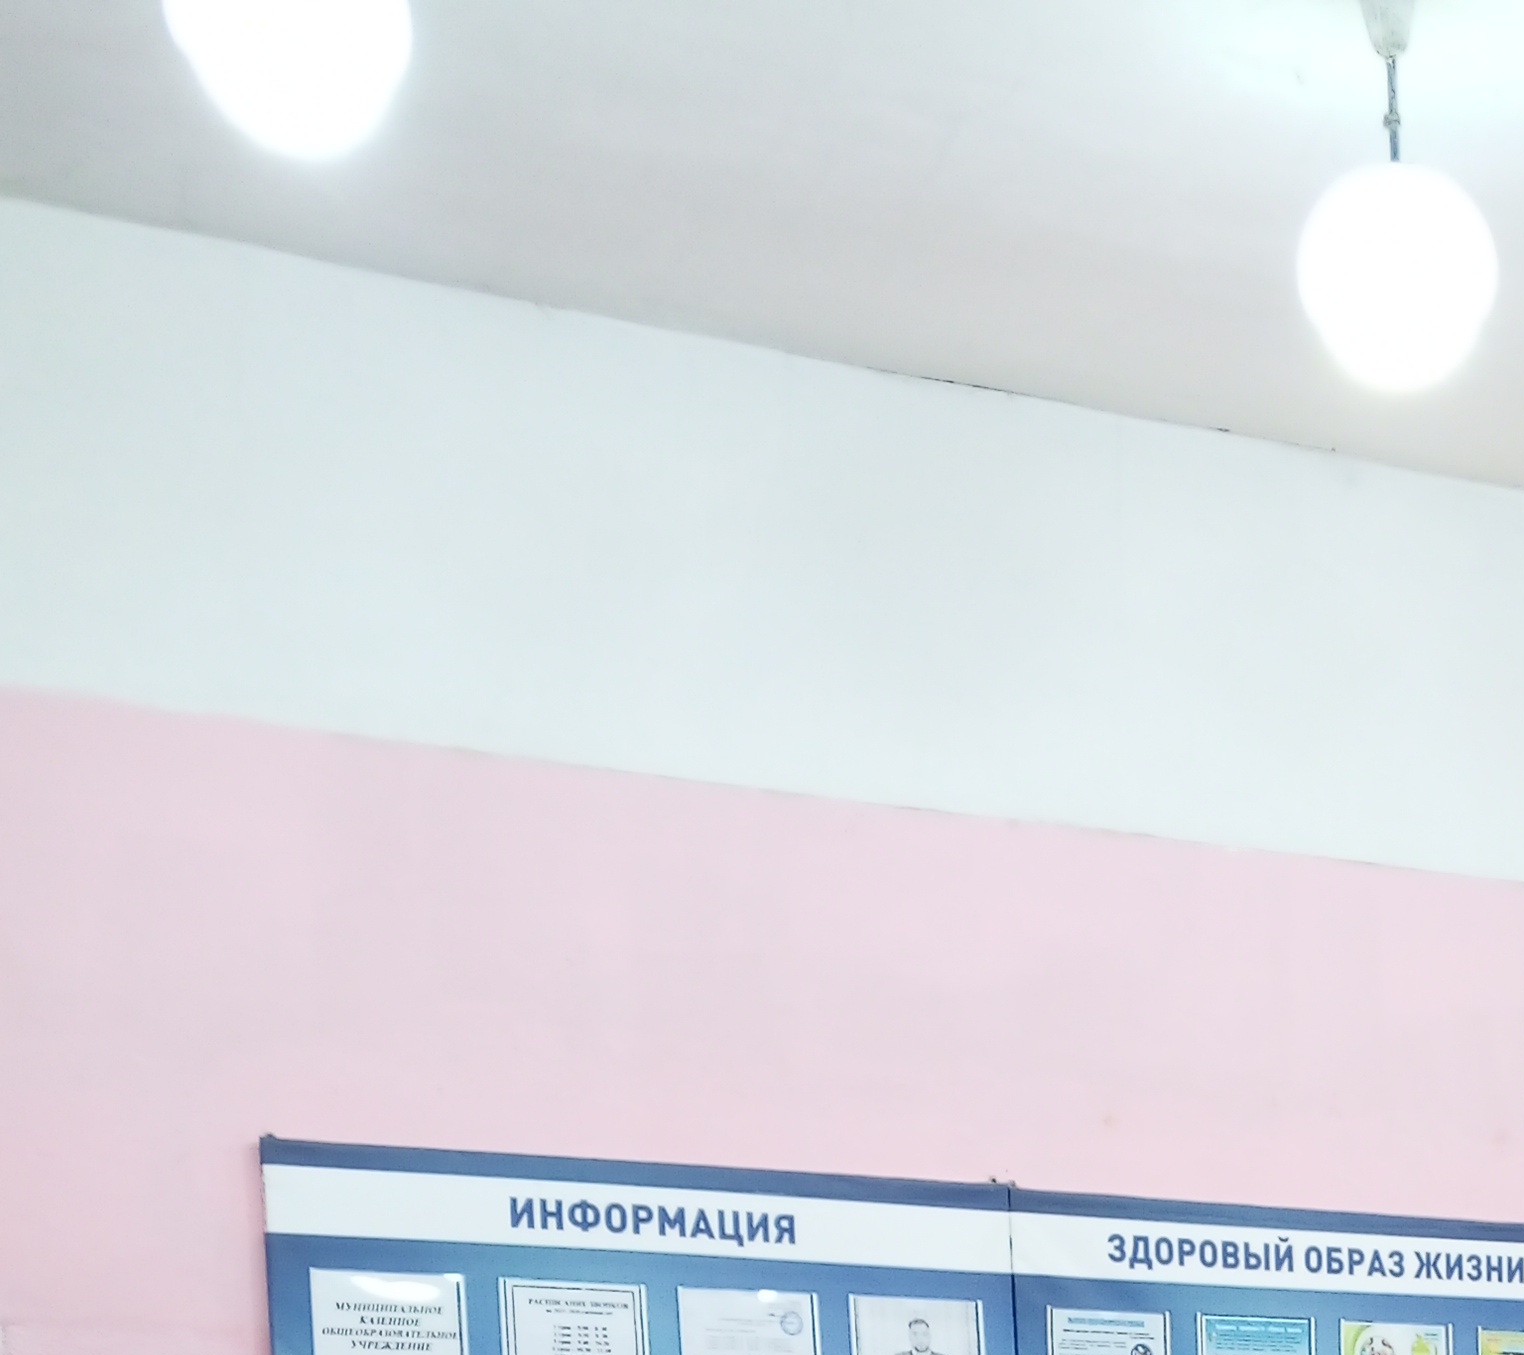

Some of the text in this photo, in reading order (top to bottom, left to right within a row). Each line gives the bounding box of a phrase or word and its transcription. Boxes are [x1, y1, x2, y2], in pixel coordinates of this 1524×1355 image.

[508, 1196, 797, 1246] ИНФОРМАЦИЯ
[1107, 1234, 1295, 1273] ЗДОРОВЫЙ
[1304, 1245, 1406, 1279] ОБРАЗ
